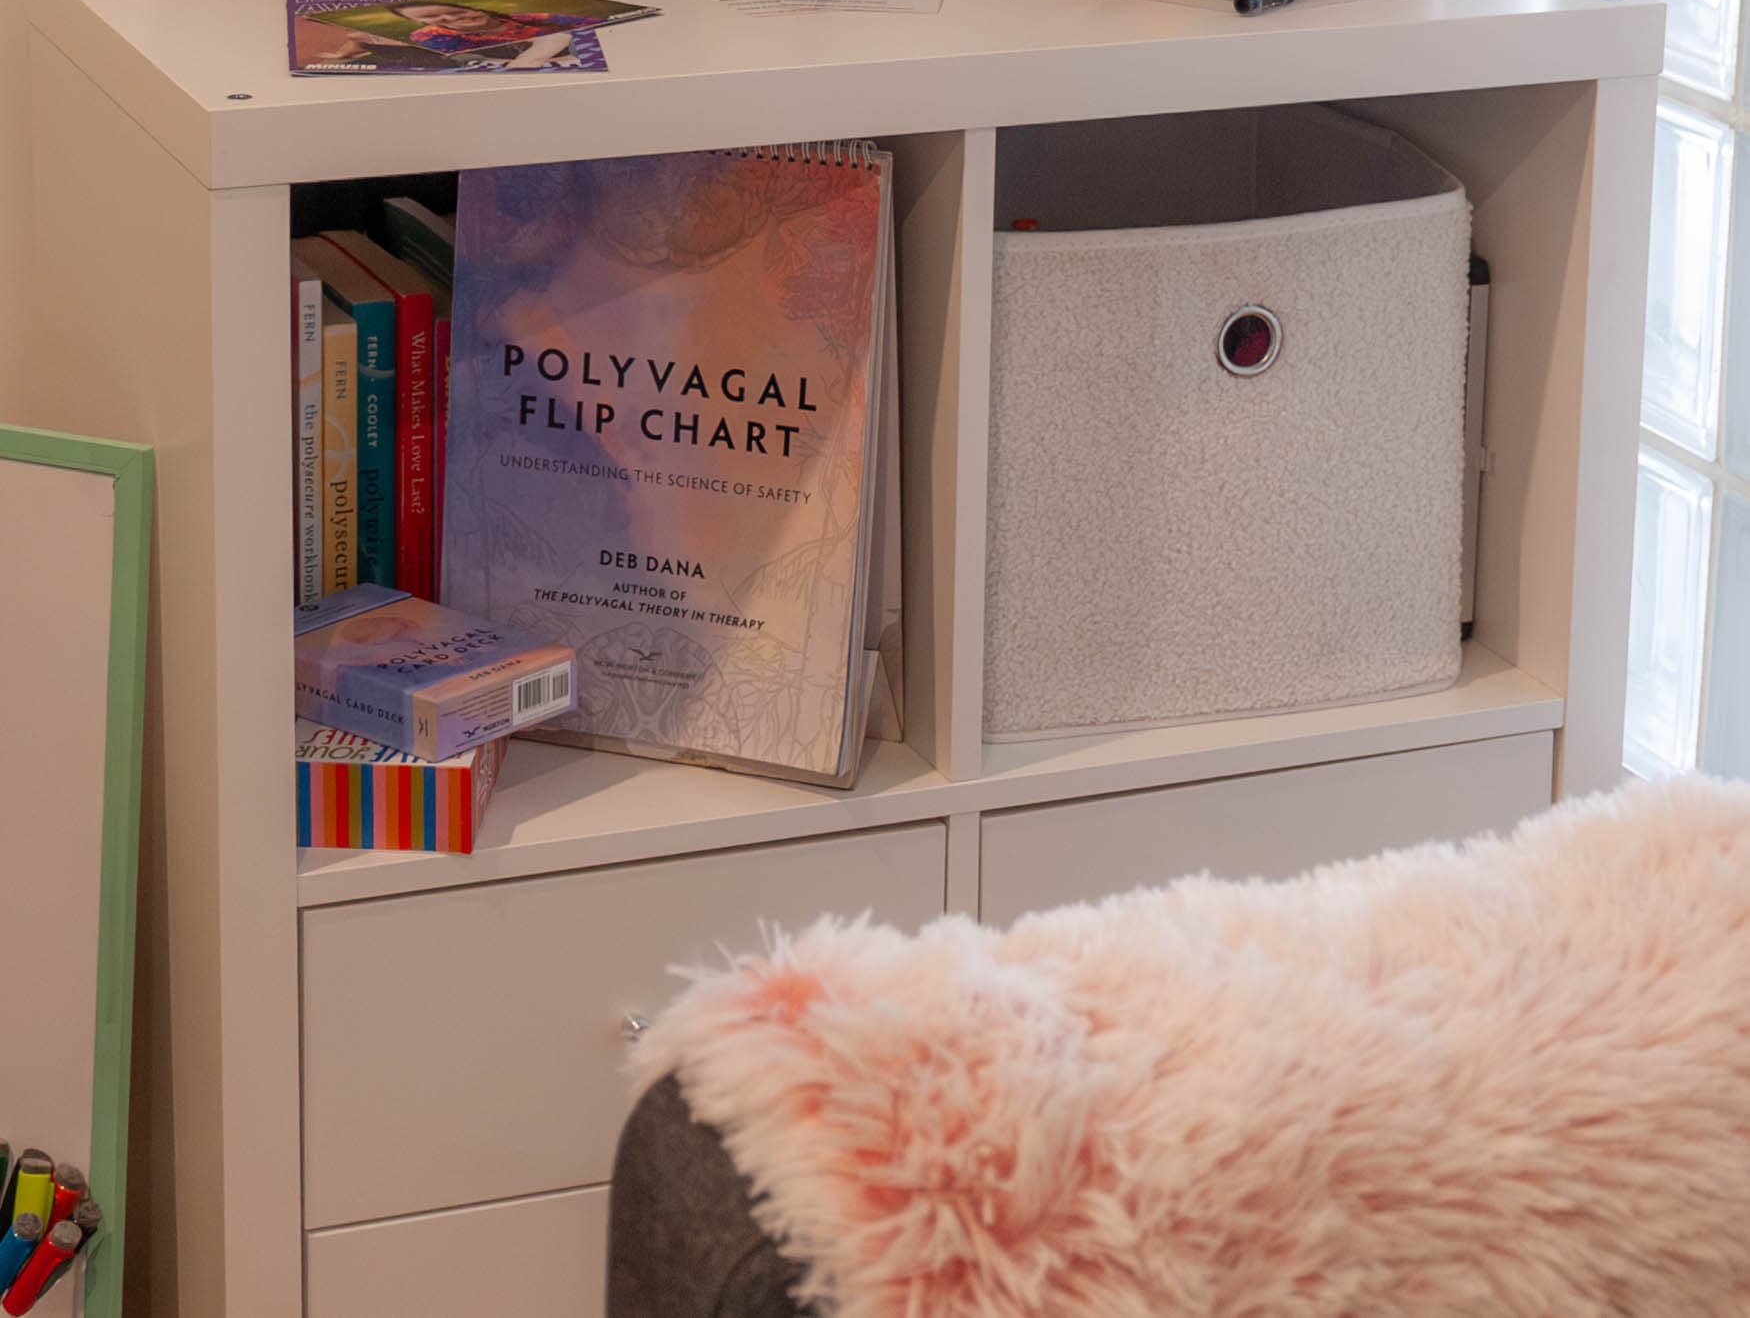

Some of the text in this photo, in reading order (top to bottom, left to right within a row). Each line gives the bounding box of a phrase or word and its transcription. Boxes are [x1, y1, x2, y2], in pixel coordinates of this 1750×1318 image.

[304, 304, 315, 342] FERN
[336, 361, 347, 399] FERN
[367, 336, 379, 448] FERN COOLEY
[504, 345, 818, 412] POLYVAGAL
[304, 404, 317, 429] the
[410, 331, 426, 515] What Makes Love Last?
[519, 395, 799, 457] FLIP CHART
[301, 436, 318, 520] polysecure
[500, 454, 812, 505] UNDERSTANDING THE SCIENCE OF SAFETY
[330, 481, 353, 589] polysecur
[600, 550, 705, 580] DEB DANA
[534, 589, 765, 631] THE POLYVAGAL THEORY IN THERAPY
[612, 582, 687, 602] AUTHOR OF
[377, 626, 494, 671] POLYVAGAL
[456, 633, 505, 654] DECK
[345, 697, 374, 715] CARD
[377, 708, 405, 724] DECK
[296, 745, 372, 760] YOUR
